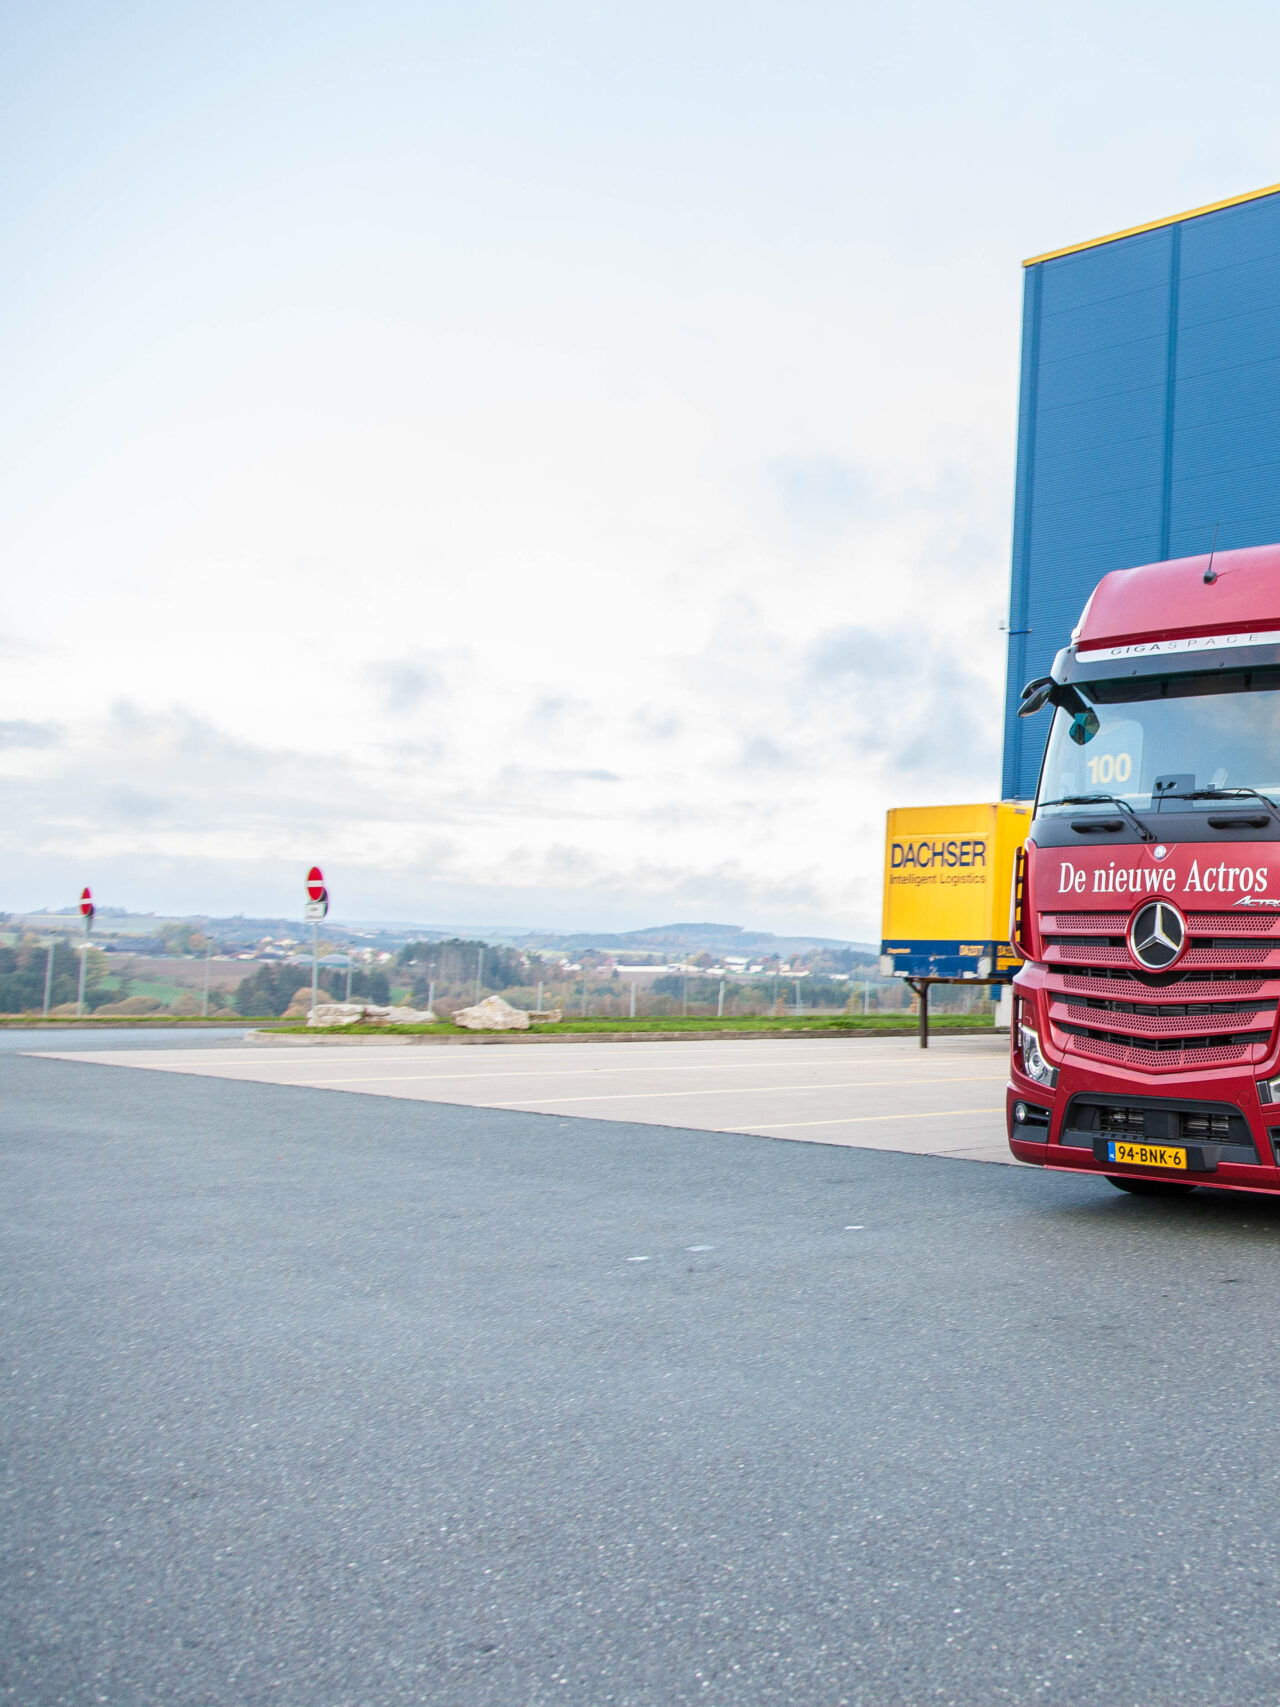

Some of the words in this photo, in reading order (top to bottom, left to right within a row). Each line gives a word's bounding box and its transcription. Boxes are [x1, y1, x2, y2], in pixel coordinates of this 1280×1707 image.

[1110, 634, 1259, 655] GIGASPACE
[1088, 752, 1132, 784] 100
[891, 841, 986, 868] DACHSER
[889, 873, 937, 887] Intelligent
[940, 872, 986, 886] Logistics
[1058, 862, 1086, 893] De
[1092, 862, 1176, 893] nieuwe
[1183, 859, 1268, 892] Actros
[1118, 1145, 1182, 1166] 94-BNK-6
